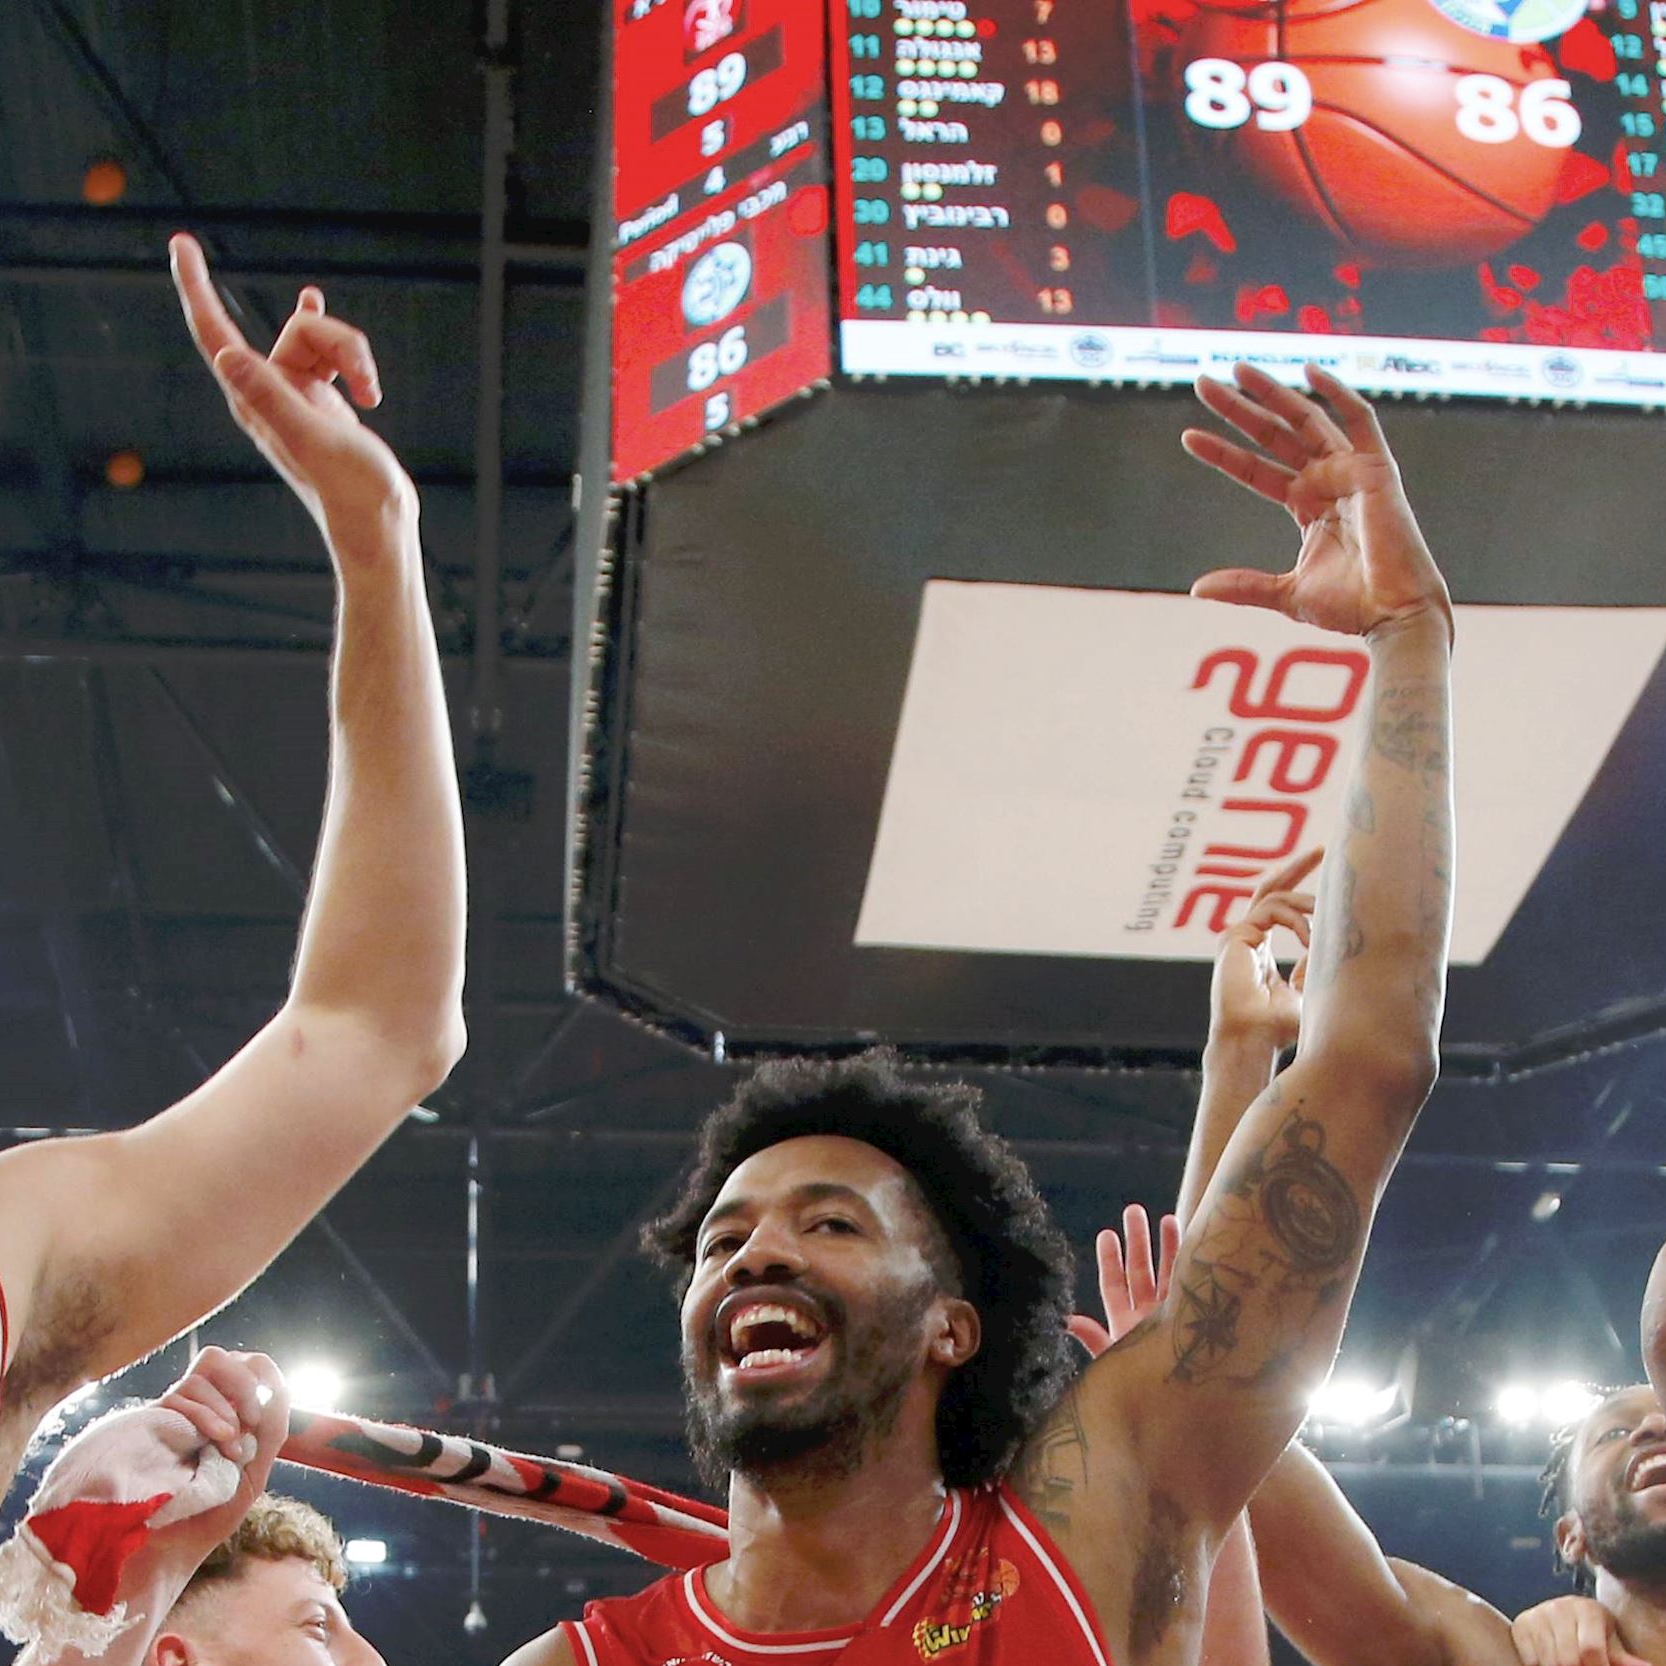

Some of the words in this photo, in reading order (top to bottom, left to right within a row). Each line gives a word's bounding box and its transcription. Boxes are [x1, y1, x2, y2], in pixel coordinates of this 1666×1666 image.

[849, 34, 880, 59] 11
[1611, 33, 1643, 60] 12
[688, 52, 747, 116] 89
[850, 74, 884, 99] 12
[1184, 57, 1313, 131] 89
[1455, 73, 1582, 148] 86
[701, 119, 724, 156] 5
[852, 115, 886, 141] 13
[852, 156, 888, 182] 20
[854, 198, 890, 225] 30
[854, 240, 889, 267] 41
[855, 283, 893, 311] 44
[687, 324, 748, 391] 86
[705, 392, 729, 431] 5
[1124, 809, 1198, 932] computing
